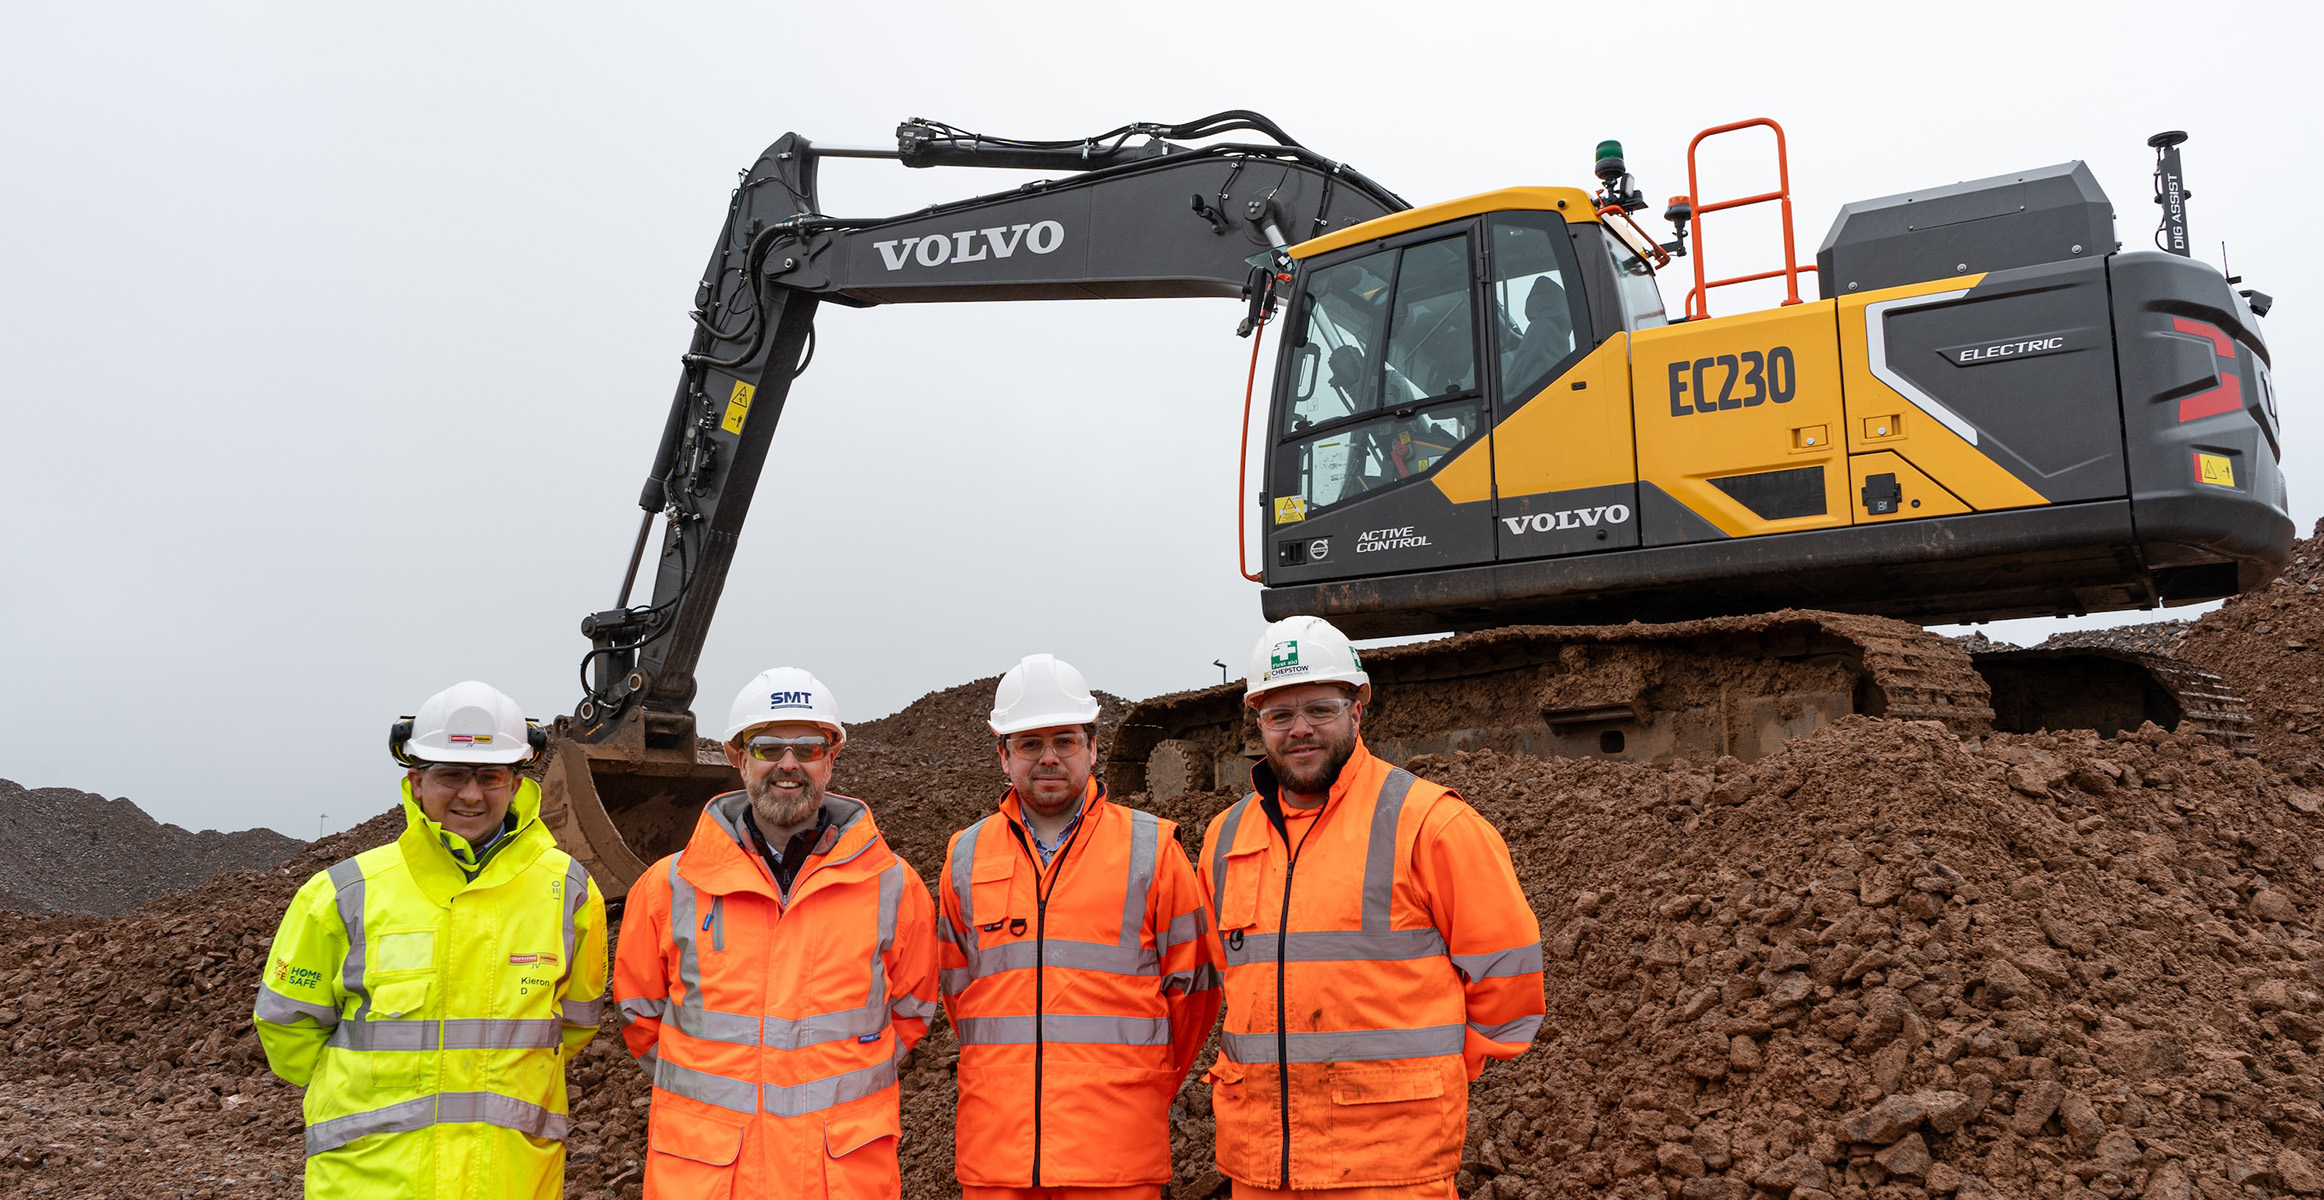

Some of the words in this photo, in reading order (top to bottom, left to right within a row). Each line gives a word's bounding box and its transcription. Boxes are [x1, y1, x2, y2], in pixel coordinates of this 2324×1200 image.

[2167, 173, 2182, 223] ASSIST
[873, 220, 1065, 271] VOLVO
[2173, 226, 2184, 249] DIG
[1960, 337, 2063, 362] ELECTRIC
[1668, 346, 1796, 417] EC230
[1502, 504, 1630, 535] VOLVO
[1358, 526, 1415, 542] ACTIVE
[1356, 536, 1432, 553] CONTROL
[1271, 665, 1309, 676] CHEPSTOW
[770, 691, 812, 705] SMT
[289, 975, 317, 989] SAFE
[291, 966, 322, 982] HOME
[521, 977, 550, 987] Kieron
[521, 987, 528, 995] D
